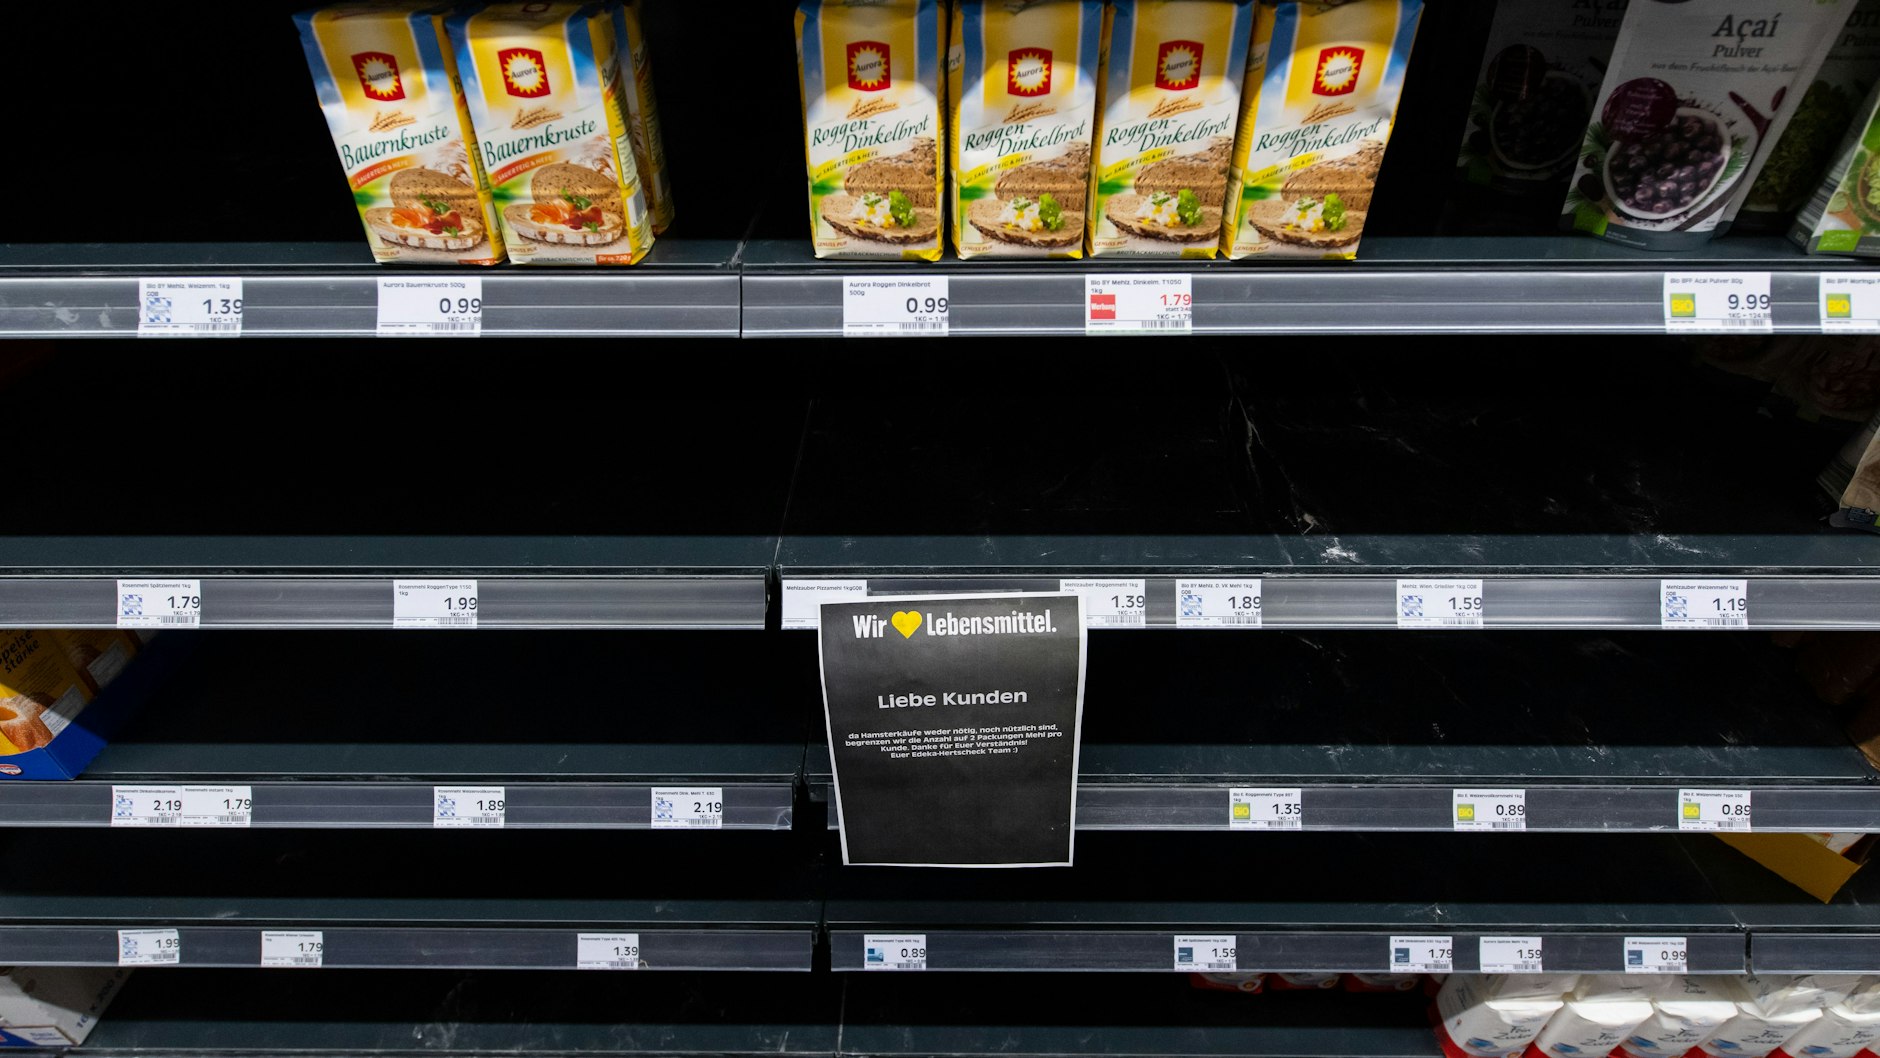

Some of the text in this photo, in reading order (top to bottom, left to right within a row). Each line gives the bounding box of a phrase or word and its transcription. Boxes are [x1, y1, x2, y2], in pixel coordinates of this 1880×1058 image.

[1711, 12, 1782, 43] Açaí
[1712, 44, 1763, 58] Pulver
[856, 60, 882, 72] Aurora
[1165, 60, 1193, 72] Aurora
[1324, 66, 1352, 79] Aurora
[367, 71, 392, 82] Aurora
[512, 67, 537, 79] Aurora
[1017, 67, 1043, 79] Aurora
[812, 119, 877, 147] Roggen-
[843, 114, 930, 153] Dinkelbrot
[964, 123, 1033, 152] Roggen-
[997, 119, 1086, 157] Dinkelbrot
[1105, 119, 1178, 147] Roggen-
[1139, 113, 1230, 152] Dinkelbrot
[1256, 124, 1329, 152] Roggen-
[1289, 117, 1382, 158] Dinkelbrot
[341, 125, 449, 170] Bauernkruste
[483, 120, 596, 167] Bauernkruste
[872, 281, 897, 289] Roggen
[203, 299, 242, 314] 1.39
[440, 298, 482, 314] 0.99
[906, 297, 948, 313] 0.99
[1160, 294, 1191, 306] 1.79
[1671, 299, 1695, 313] BIO
[1728, 294, 1770, 310] 9.99
[1827, 299, 1850, 313] BIO
[168, 596, 200, 609] 1.79
[444, 597, 477, 610] 1.99
[1112, 595, 1145, 608] 1.39
[1228, 596, 1261, 609] 1.89
[1449, 597, 1482, 610] 1.59
[1713, 598, 1746, 611] 1.19
[853, 609, 1057, 638] Wir Lebensmittel.
[0, 630, 33, 664] peise
[5, 640, 39, 673] stärke
[878, 690, 1028, 709] Liebe Kunden
[845, 739, 890, 747] begrenzen
[977, 732, 1023, 741] Packungen
[861, 730, 922, 739] Hamsterkäufe
[953, 727, 978, 735] nötig,
[976, 739, 1028, 747] Verständnis!
[911, 748, 986, 758] Edeka-Hertscheck
[153, 800, 182, 811] 2.19
[223, 799, 252, 810] 1.79
[476, 800, 505, 811] 1.89
[694, 801, 722, 813] 2.19
[1234, 806, 1250, 816] BIO
[1272, 803, 1301, 815] 1.35
[1496, 804, 1525, 816] 0.89
[1684, 806, 1700, 816] BIO
[1722, 804, 1751, 816] 0.89
[1458, 808, 1474, 817] BIO
[156, 939, 180, 949] 1.99
[298, 943, 323, 952] 1.79
[613, 946, 639, 956] 1.39
[901, 948, 926, 958] 0.89
[1212, 948, 1237, 958] 1.59
[1428, 949, 1453, 959] 1.79
[1517, 949, 1542, 959] 1.59
[1661, 951, 1687, 961] 0.99
